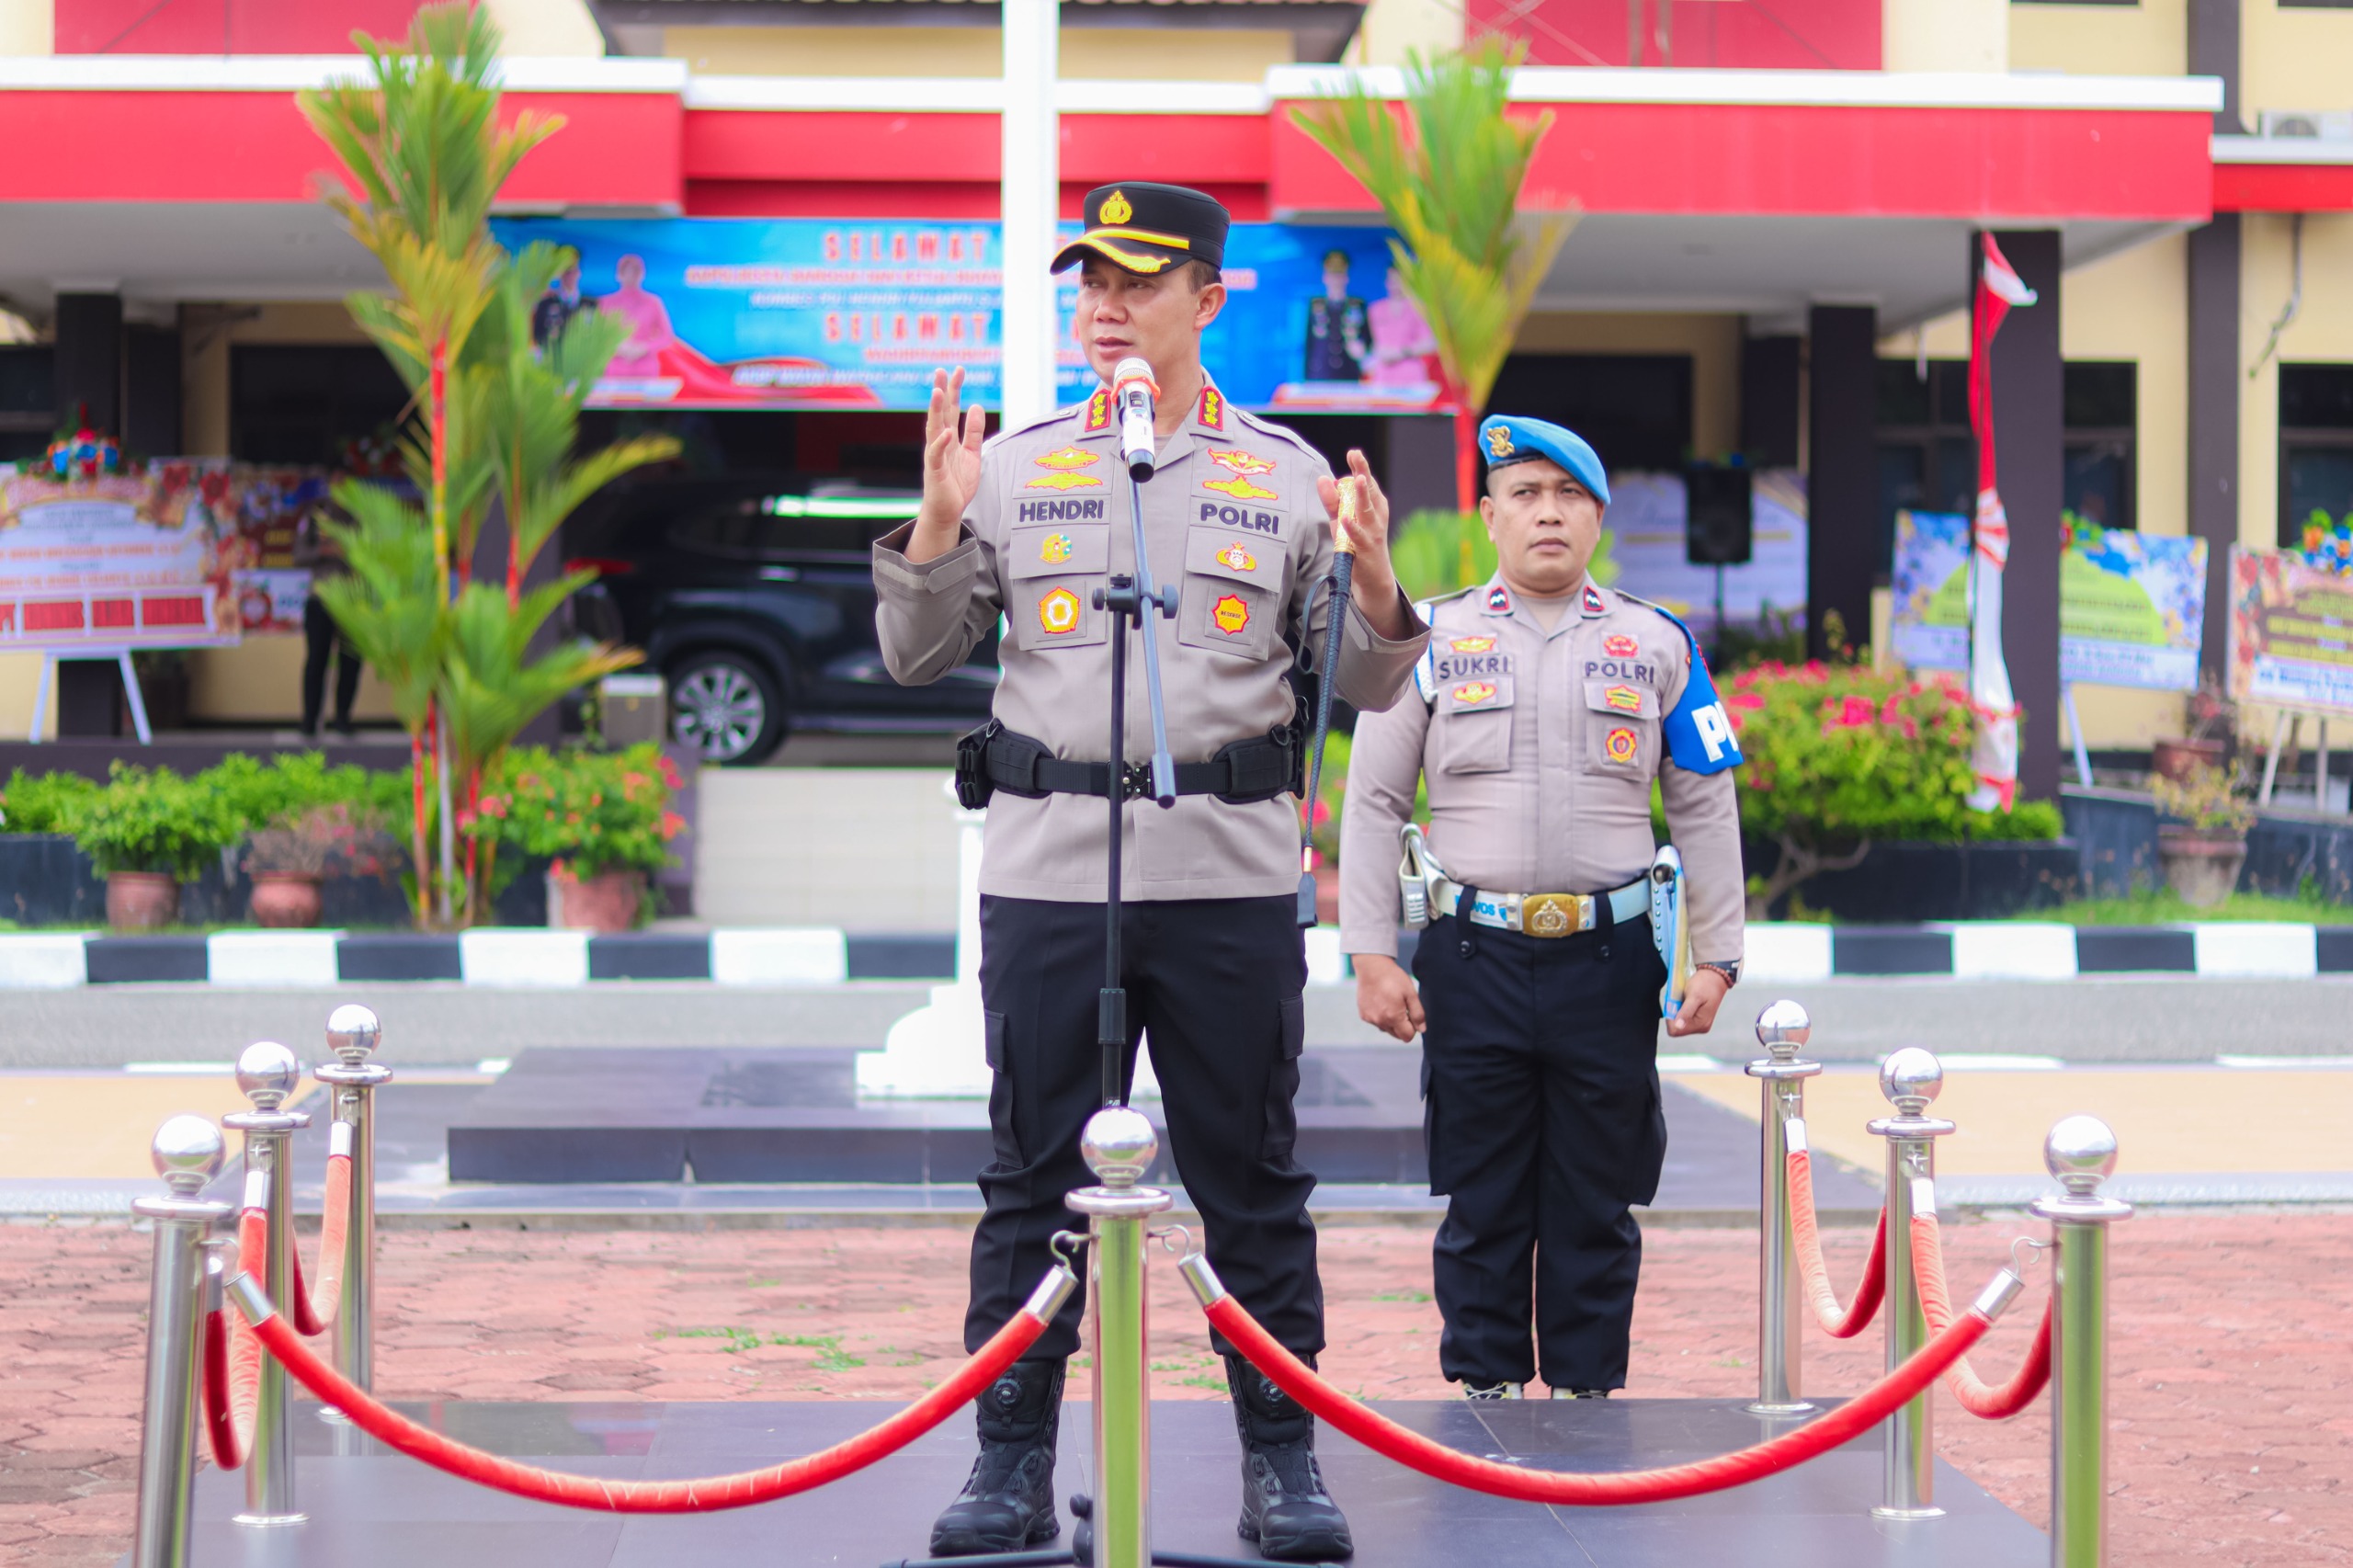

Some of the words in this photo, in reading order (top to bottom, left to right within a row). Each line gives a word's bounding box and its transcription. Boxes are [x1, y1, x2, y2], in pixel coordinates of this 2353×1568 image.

[824, 233, 987, 262] SELAMAT
[824, 312, 988, 341] SELAMAT
[1019, 500, 1104, 522] HENDRI
[1200, 503, 1279, 535] POLRI
[1438, 655, 1508, 679] SUKRI
[1585, 661, 1654, 684] POLRI
